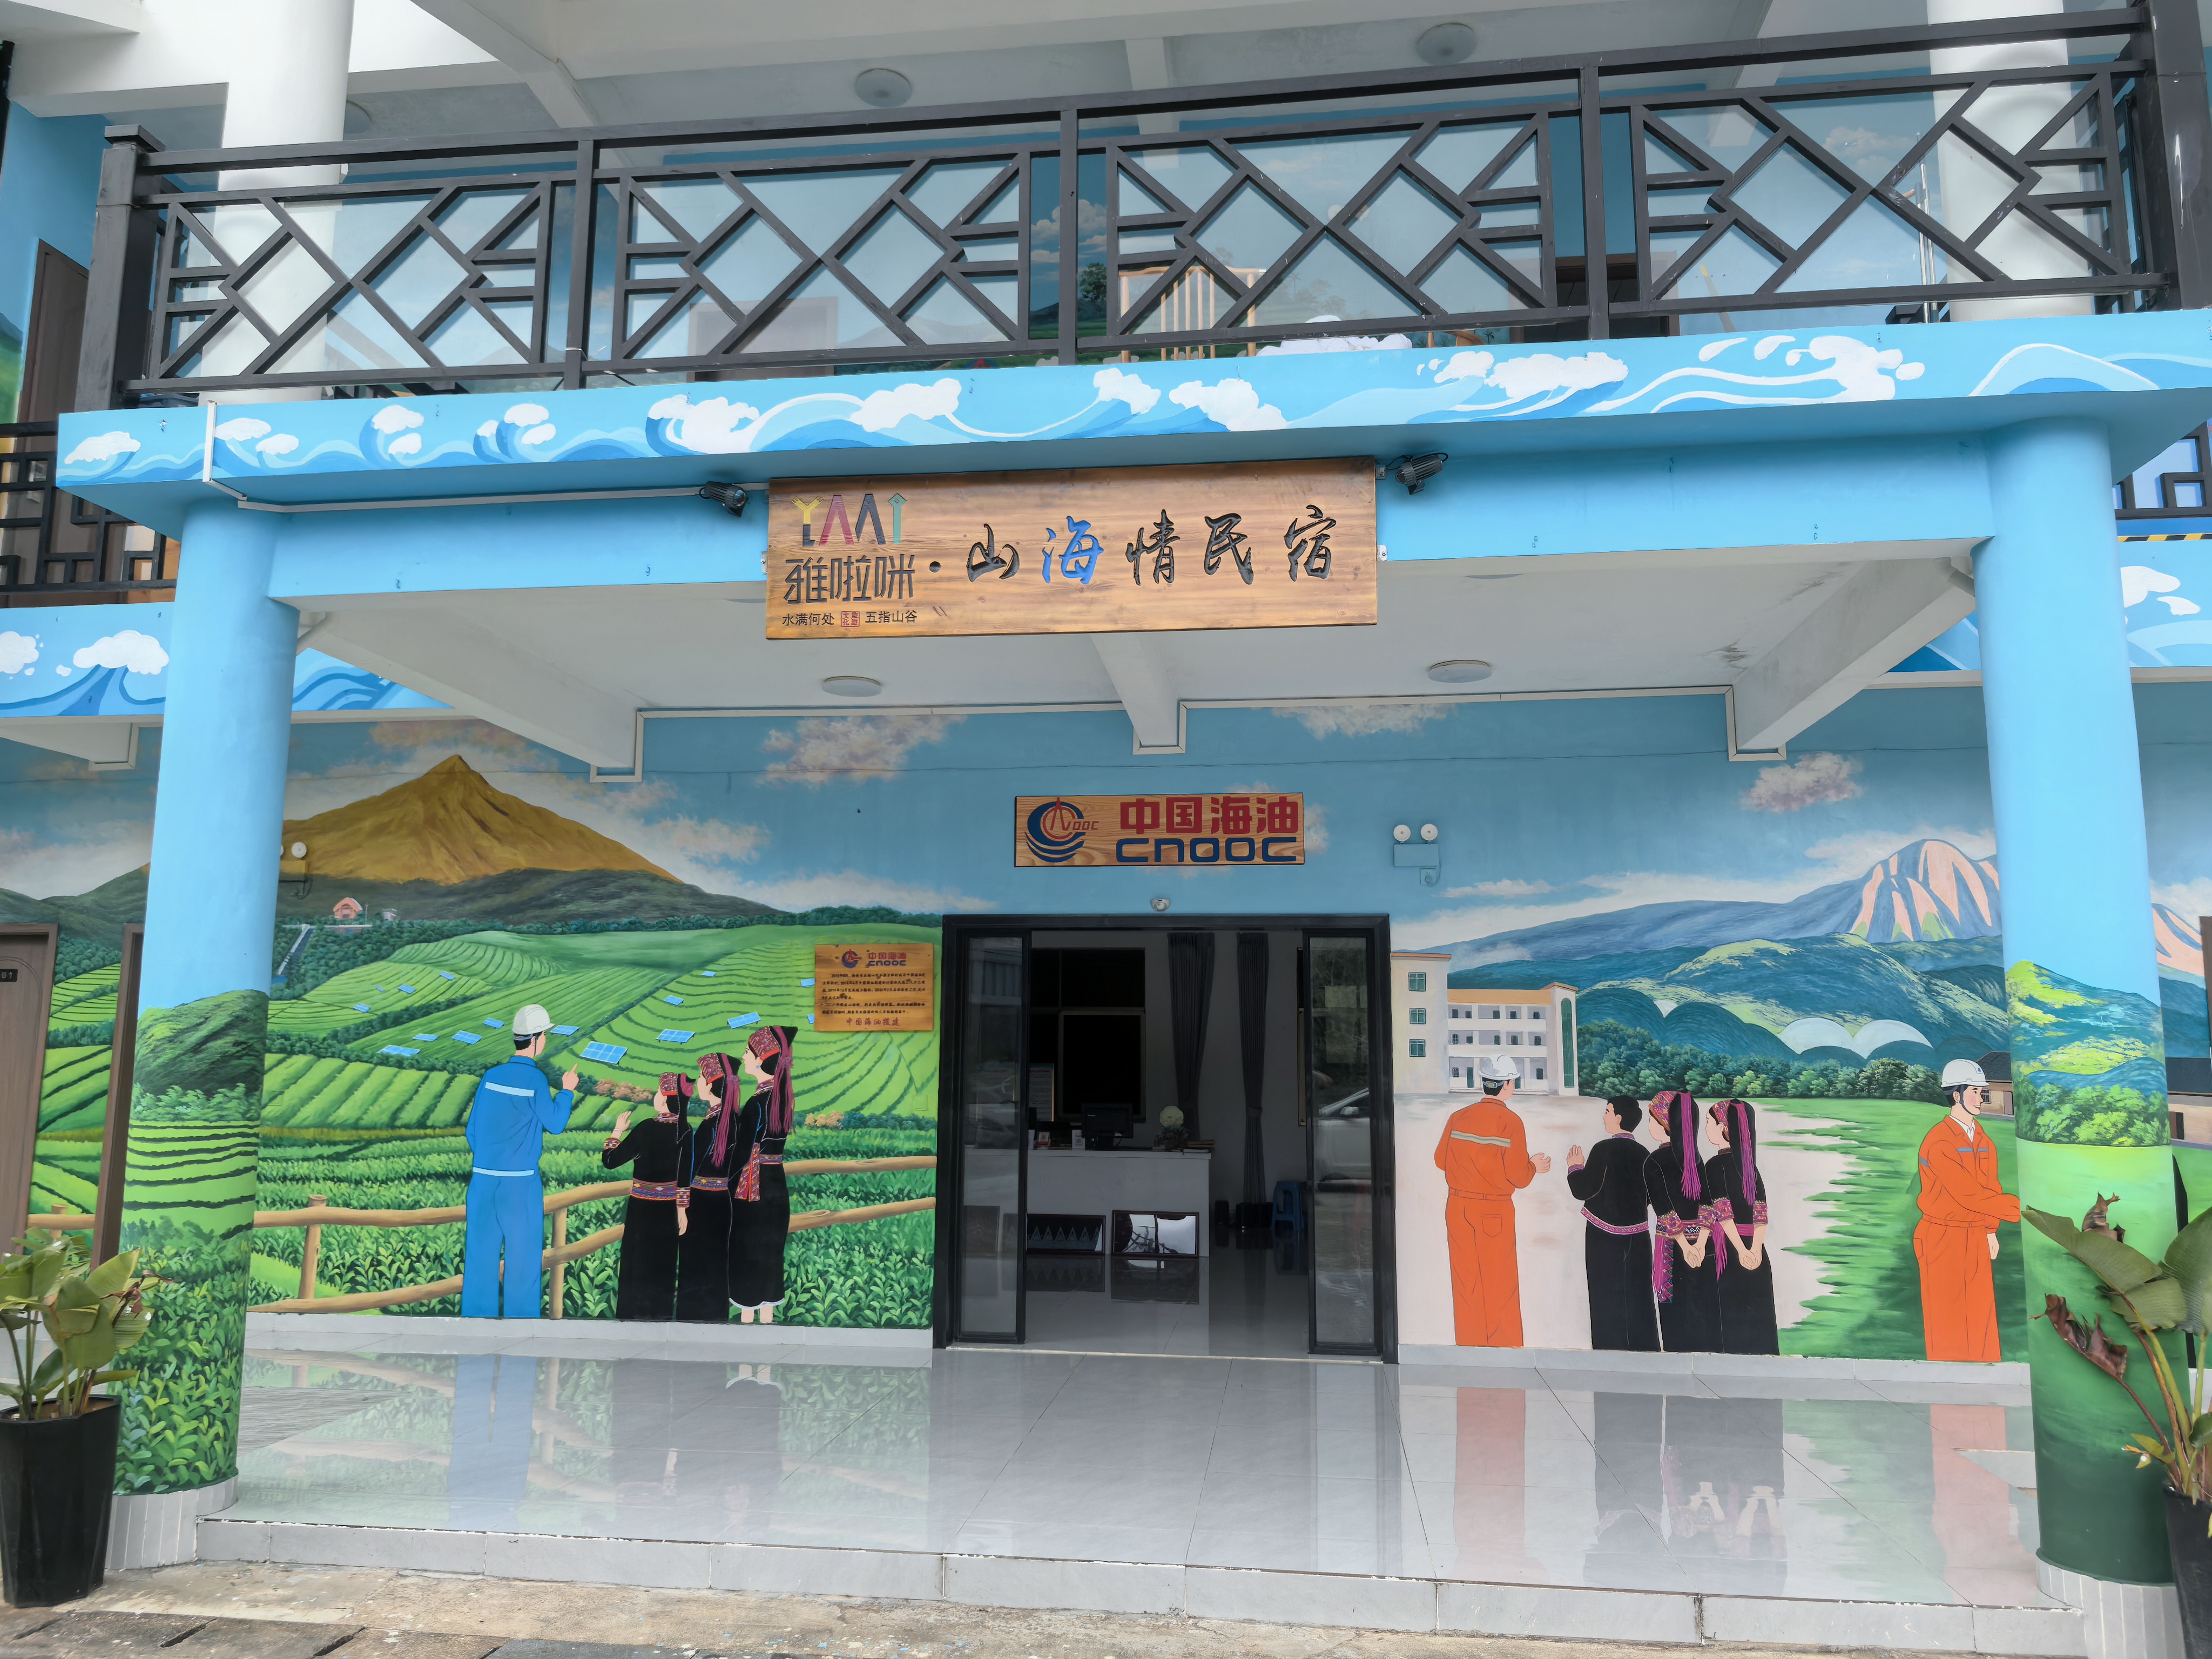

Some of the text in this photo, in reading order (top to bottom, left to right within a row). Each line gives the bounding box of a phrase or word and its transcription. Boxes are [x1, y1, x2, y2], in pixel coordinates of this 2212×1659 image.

[967, 503, 1338, 586] 山海情民宿
[782, 612, 835, 626] 水满何处
[865, 610, 918, 624] 五指山谷
[1120, 797, 1298, 834] 中国海油
